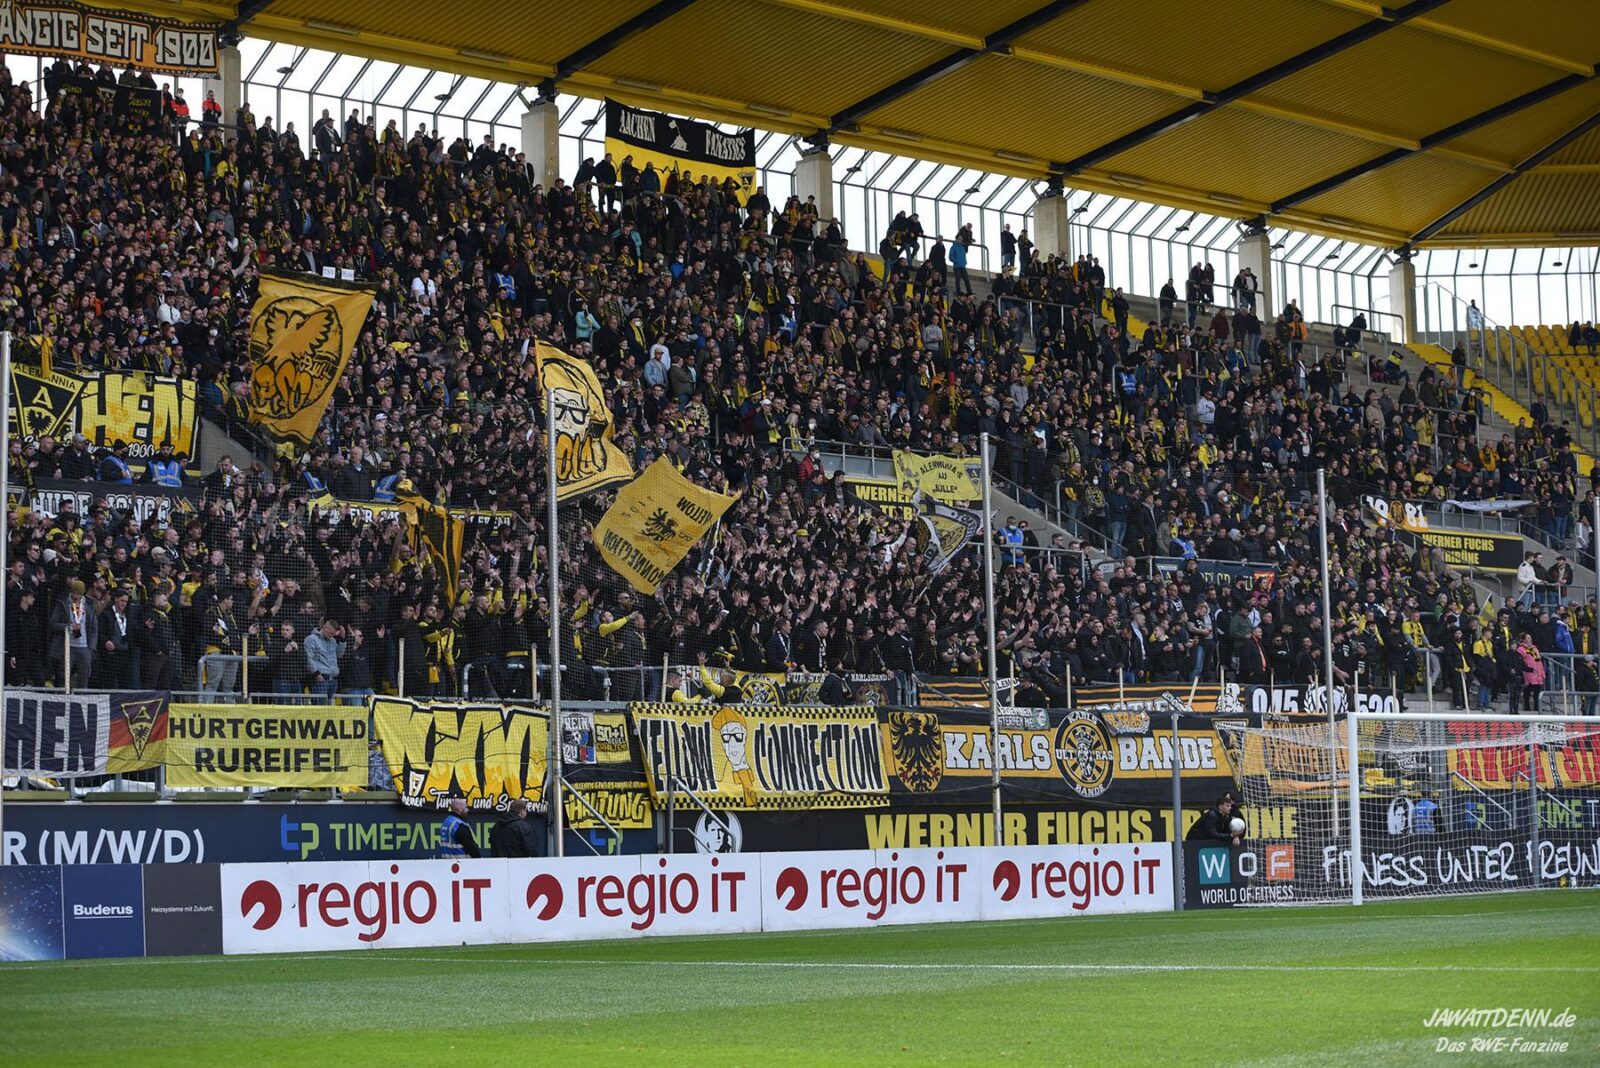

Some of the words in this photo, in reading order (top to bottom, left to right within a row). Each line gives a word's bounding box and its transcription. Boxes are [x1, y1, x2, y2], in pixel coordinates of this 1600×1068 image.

[87, 16, 149, 61] SEIT
[155, 27, 217, 67] 1900
[619, 109, 656, 142] AACHEN
[705, 129, 747, 161] FANATICS
[14, 363, 76, 391] ALEMNNIA
[1422, 533, 1462, 549] WERNER
[1463, 537, 1495, 552] FUCHS
[1443, 550, 1480, 565] RIBÜNE
[4, 698, 98, 771] HEN
[169, 713, 367, 741] HÜRTGENWALD
[195, 747, 349, 773] RUREIFEL
[639, 718, 718, 792] YELLOW
[754, 722, 884, 792] CONNECTION
[943, 731, 1052, 771] KARLS
[1117, 736, 1219, 771] BANDE
[1075, 782, 1107, 799] BANDE
[1037, 809, 1153, 845] FUCHS
[1160, 803, 1299, 842] TRÜNE
[1536, 799, 1583, 830] TIME
[38, 828, 205, 865] (M/W/D)
[329, 822, 497, 851] TIMEPARNE
[1031, 847, 1124, 911] regio
[1133, 845, 1161, 895] iT
[1321, 845, 1428, 887] FITNESS
[1437, 841, 1519, 884] UNTER
[298, 863, 437, 942] regio
[451, 862, 491, 922] iT
[578, 857, 699, 931] regio
[711, 856, 746, 912] iT
[820, 852, 925, 920] regio
[936, 850, 968, 903] iT
[1200, 888, 1237, 904] WORLD
[1240, 887, 1252, 902] OF
[1254, 884, 1294, 901] FITNESS
[73, 903, 134, 916] Buderus
[151, 906, 183, 914] Heizsysteme
[184, 905, 193, 913] mit
[193, 905, 215, 913] Zukunft.
